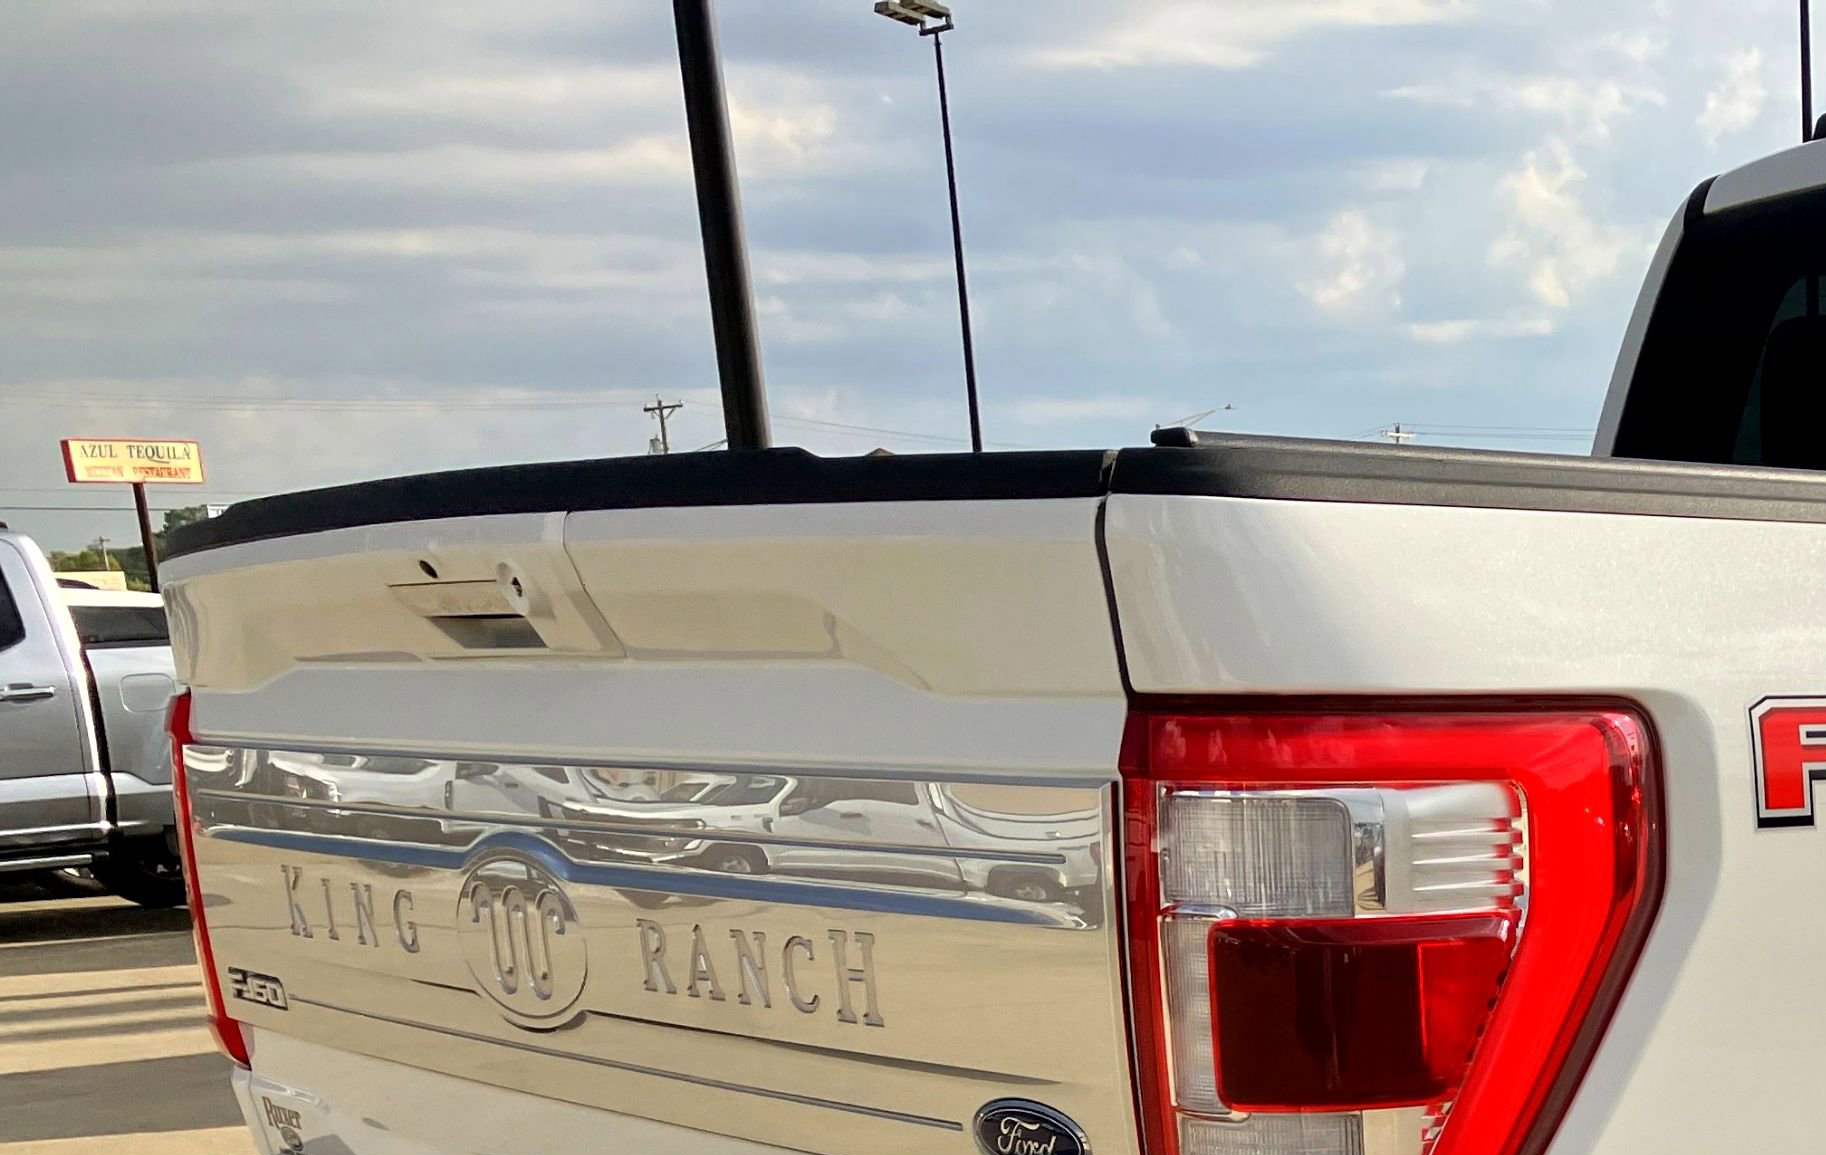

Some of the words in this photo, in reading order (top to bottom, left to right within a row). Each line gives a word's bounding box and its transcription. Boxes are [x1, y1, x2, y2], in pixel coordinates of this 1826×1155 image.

[80, 444, 118, 458] AZUL
[126, 443, 191, 464] TEQUILA
[281, 864, 420, 953] KING
[635, 917, 886, 1029] RANCH
